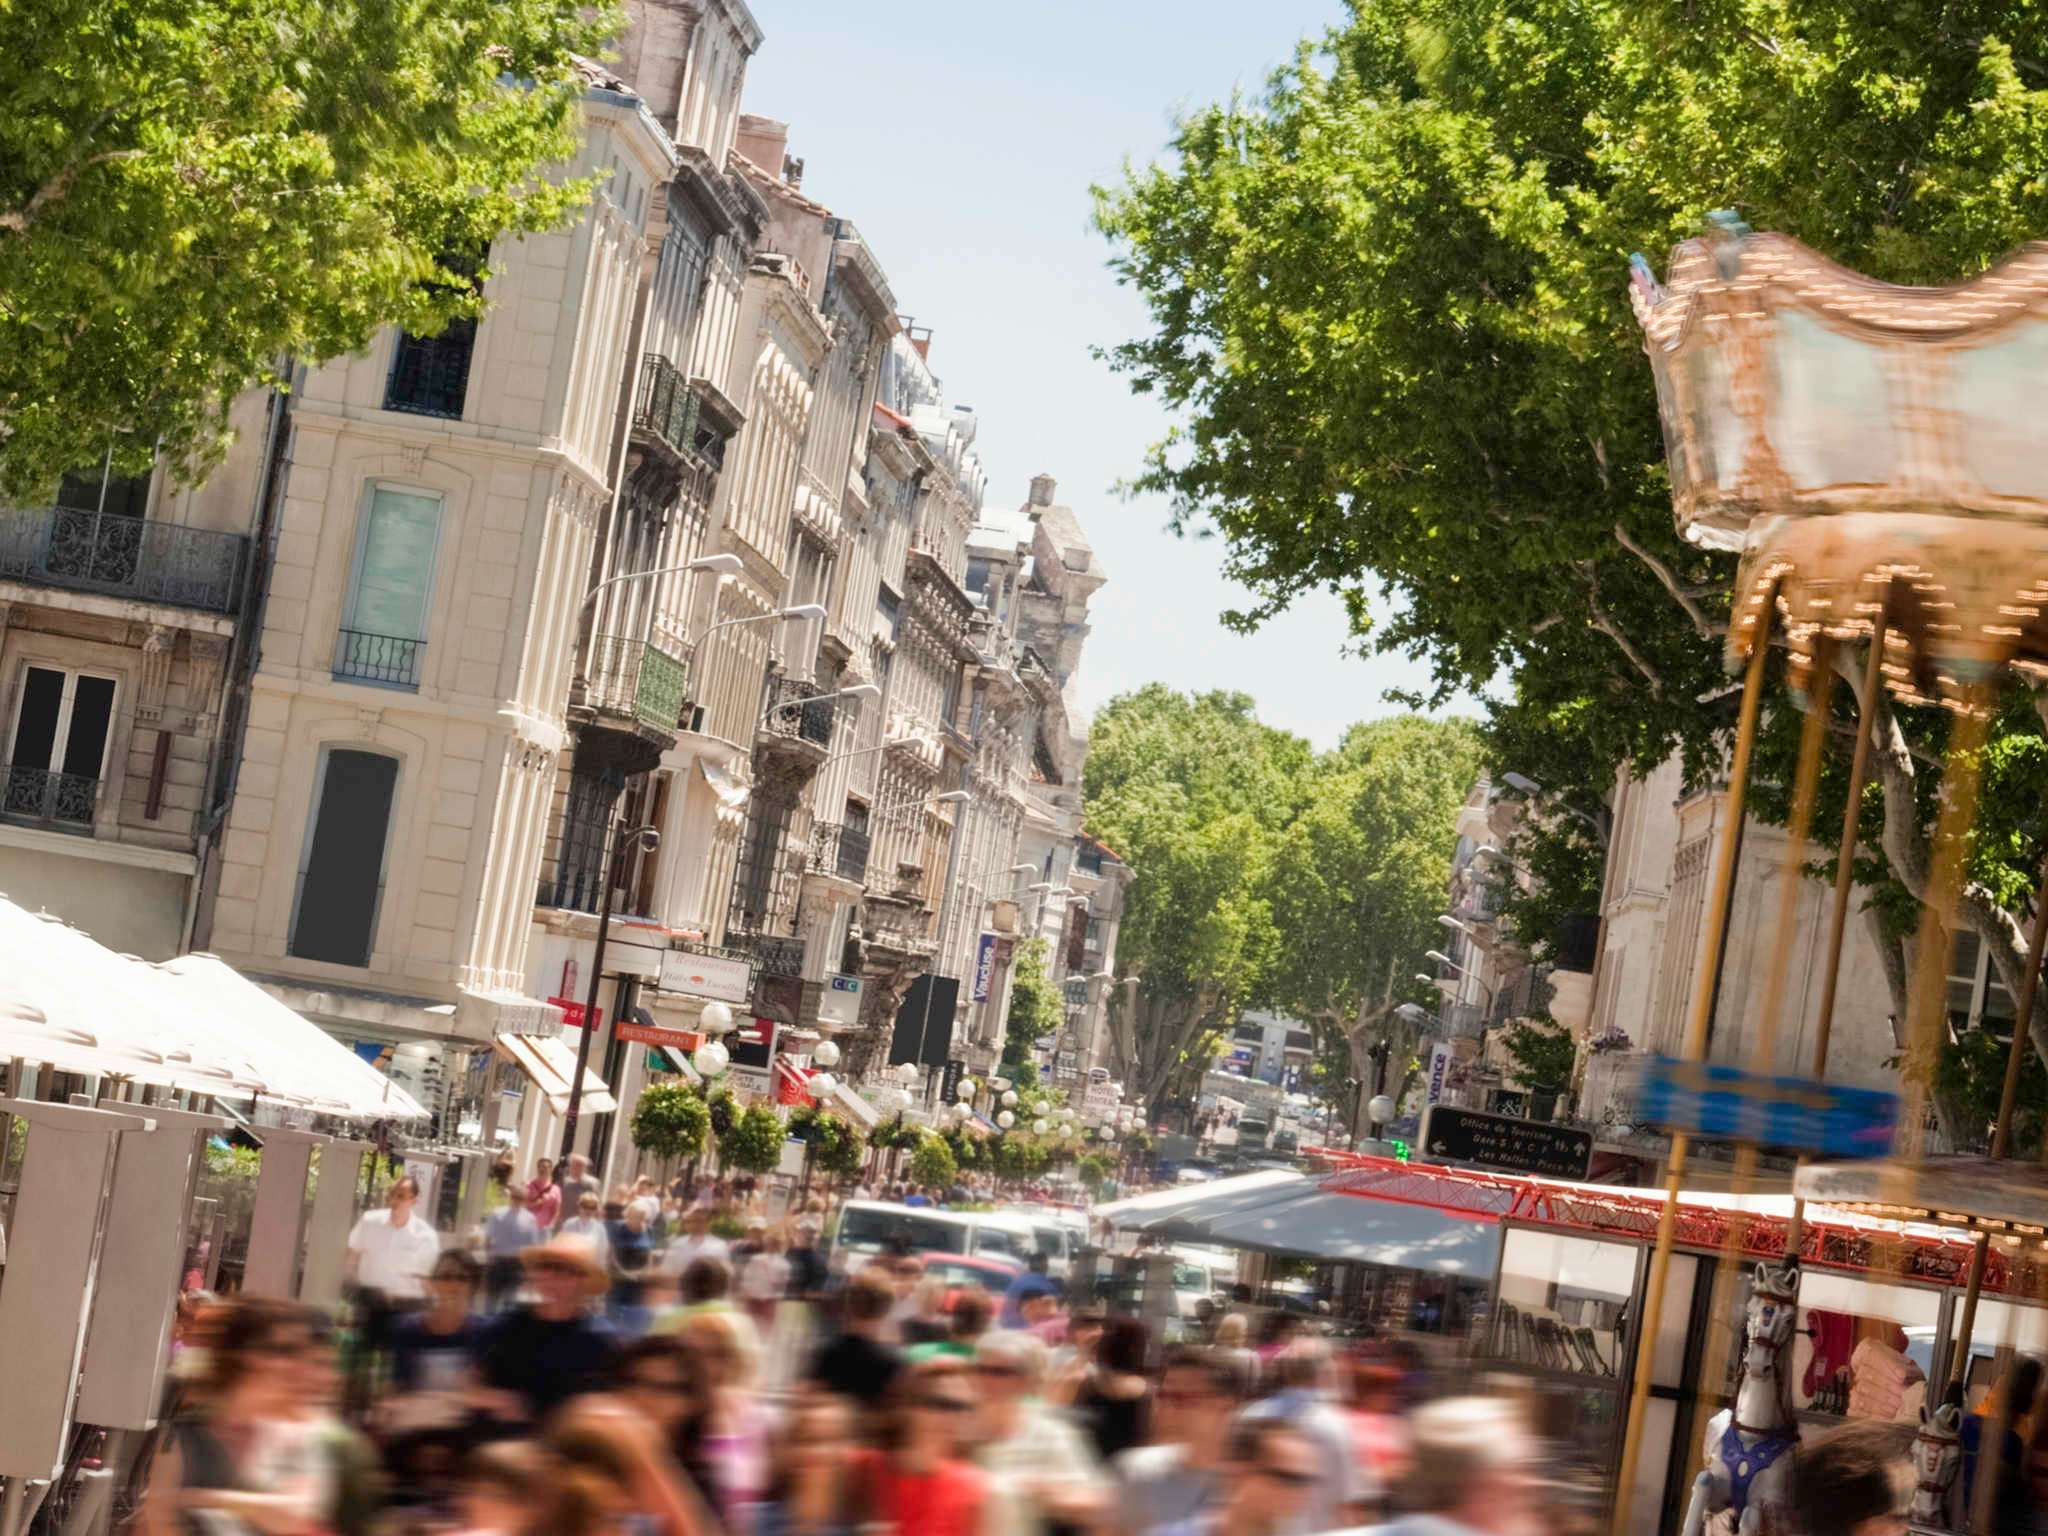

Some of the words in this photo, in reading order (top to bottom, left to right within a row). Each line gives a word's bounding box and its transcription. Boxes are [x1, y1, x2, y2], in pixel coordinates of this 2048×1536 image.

[675, 954, 740, 973] Restaurant
[975, 946, 993, 999] Vaucluse
[834, 978, 857, 992] CIC
[622, 1026, 689, 1046] RESTAURANT
[1428, 1055, 1446, 1103] vence
[1090, 1086, 1114, 1098] HOTEL
[1460, 1118, 1489, 1130] Office
[1511, 1126, 1552, 1141] Tourisme
[1472, 1134, 1496, 1146] Gare
[1479, 1149, 1496, 1160] Les
[1499, 1153, 1529, 1166] Halles
